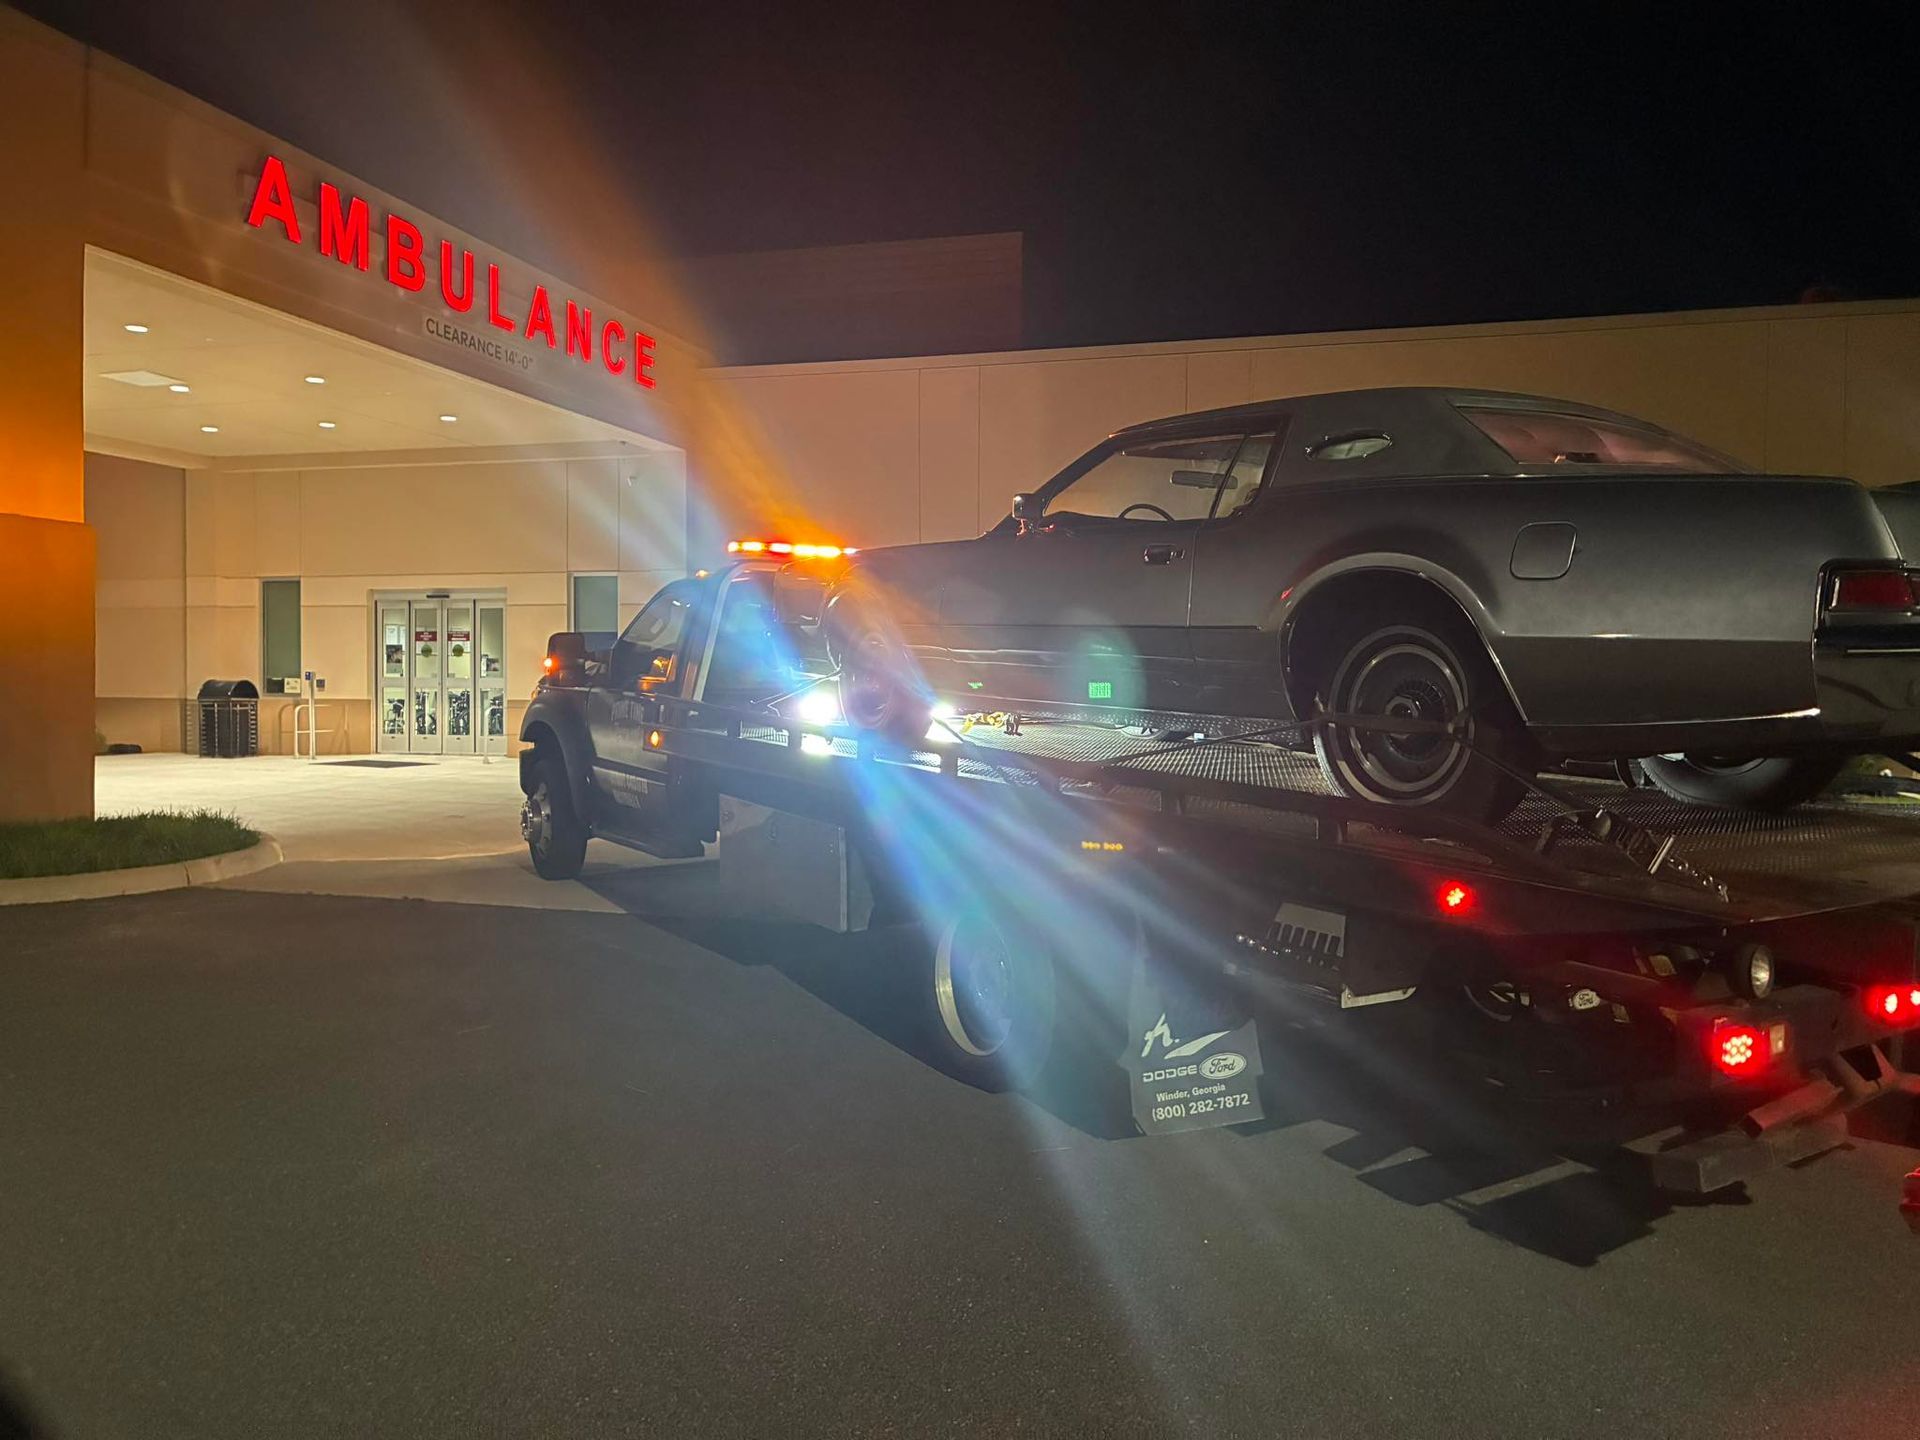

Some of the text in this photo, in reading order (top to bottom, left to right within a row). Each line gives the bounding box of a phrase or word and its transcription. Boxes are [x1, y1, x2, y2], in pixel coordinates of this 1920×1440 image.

[247, 155, 657, 389] AMBULANCE
[425, 317, 502, 361] CLEARANCE
[1142, 1064, 1198, 1083] DODGE
[1156, 1083, 1226, 1102] Winder, Georgia
[1152, 1093, 1251, 1122] (800) 282-7872
